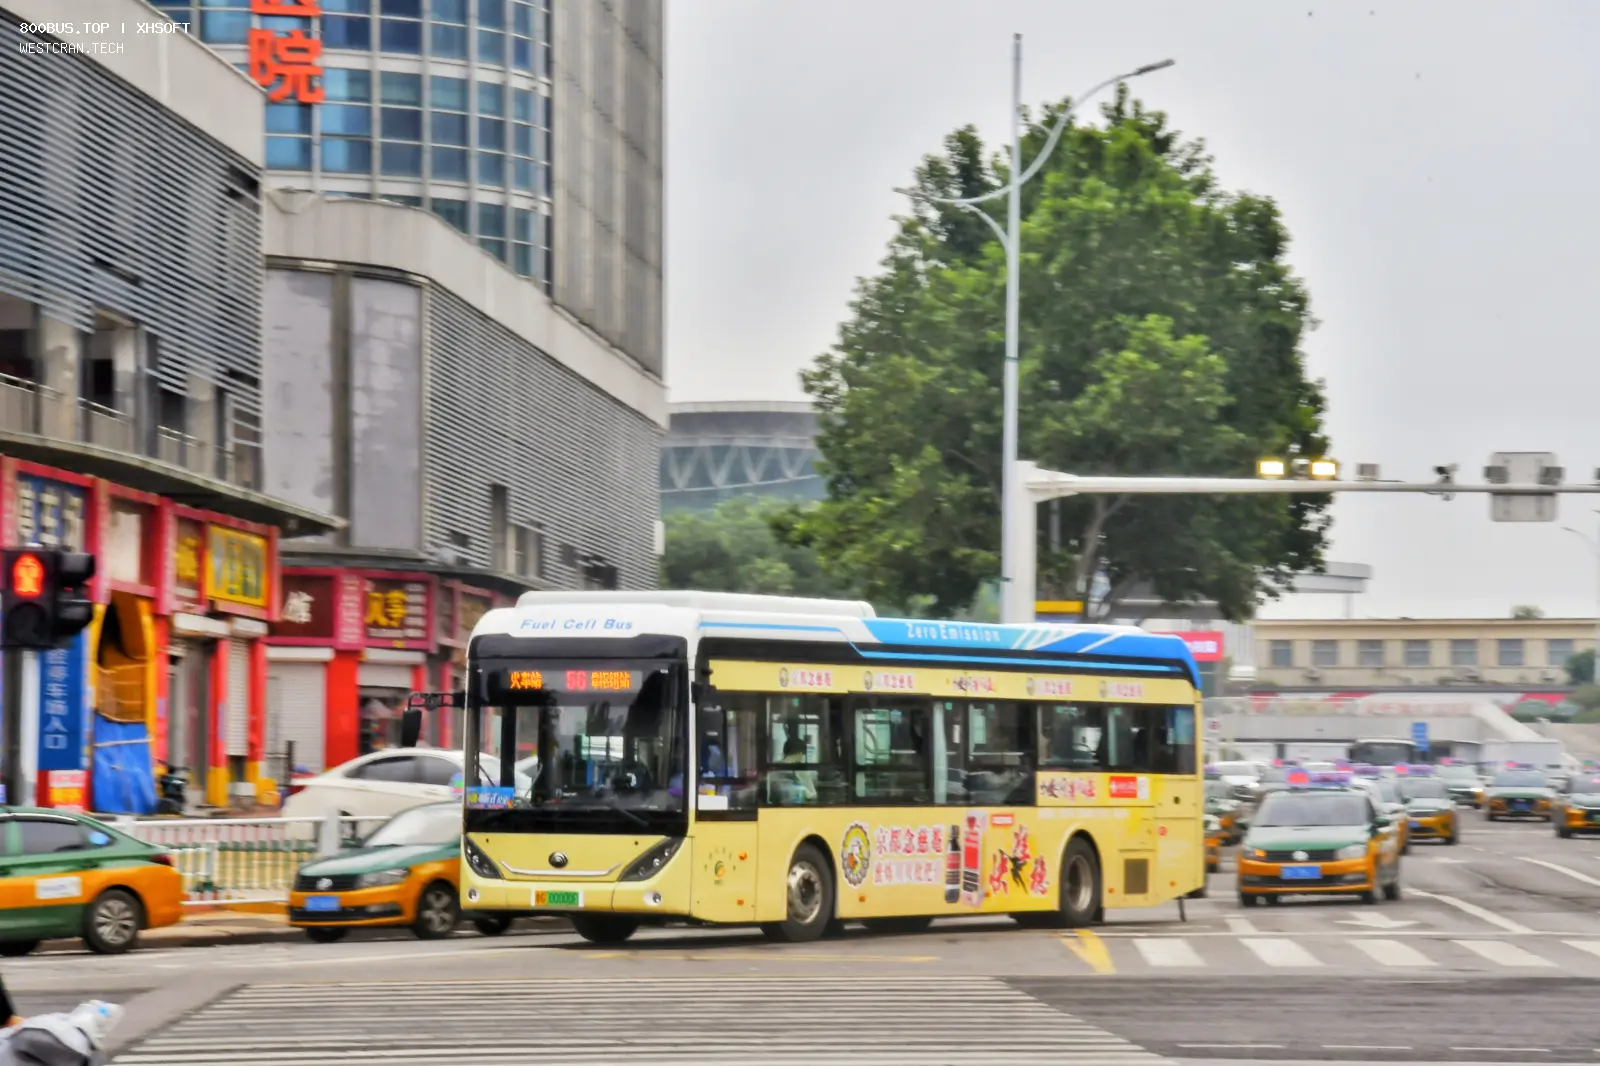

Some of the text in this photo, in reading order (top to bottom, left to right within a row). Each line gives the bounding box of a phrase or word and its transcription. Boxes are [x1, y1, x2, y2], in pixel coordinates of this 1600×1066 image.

[247, 0, 325, 104] 院
[520, 618, 633, 630] Fuel Cell Bus
[906, 622, 1000, 642] Zero Emission
[510, 670, 544, 690] 火车站
